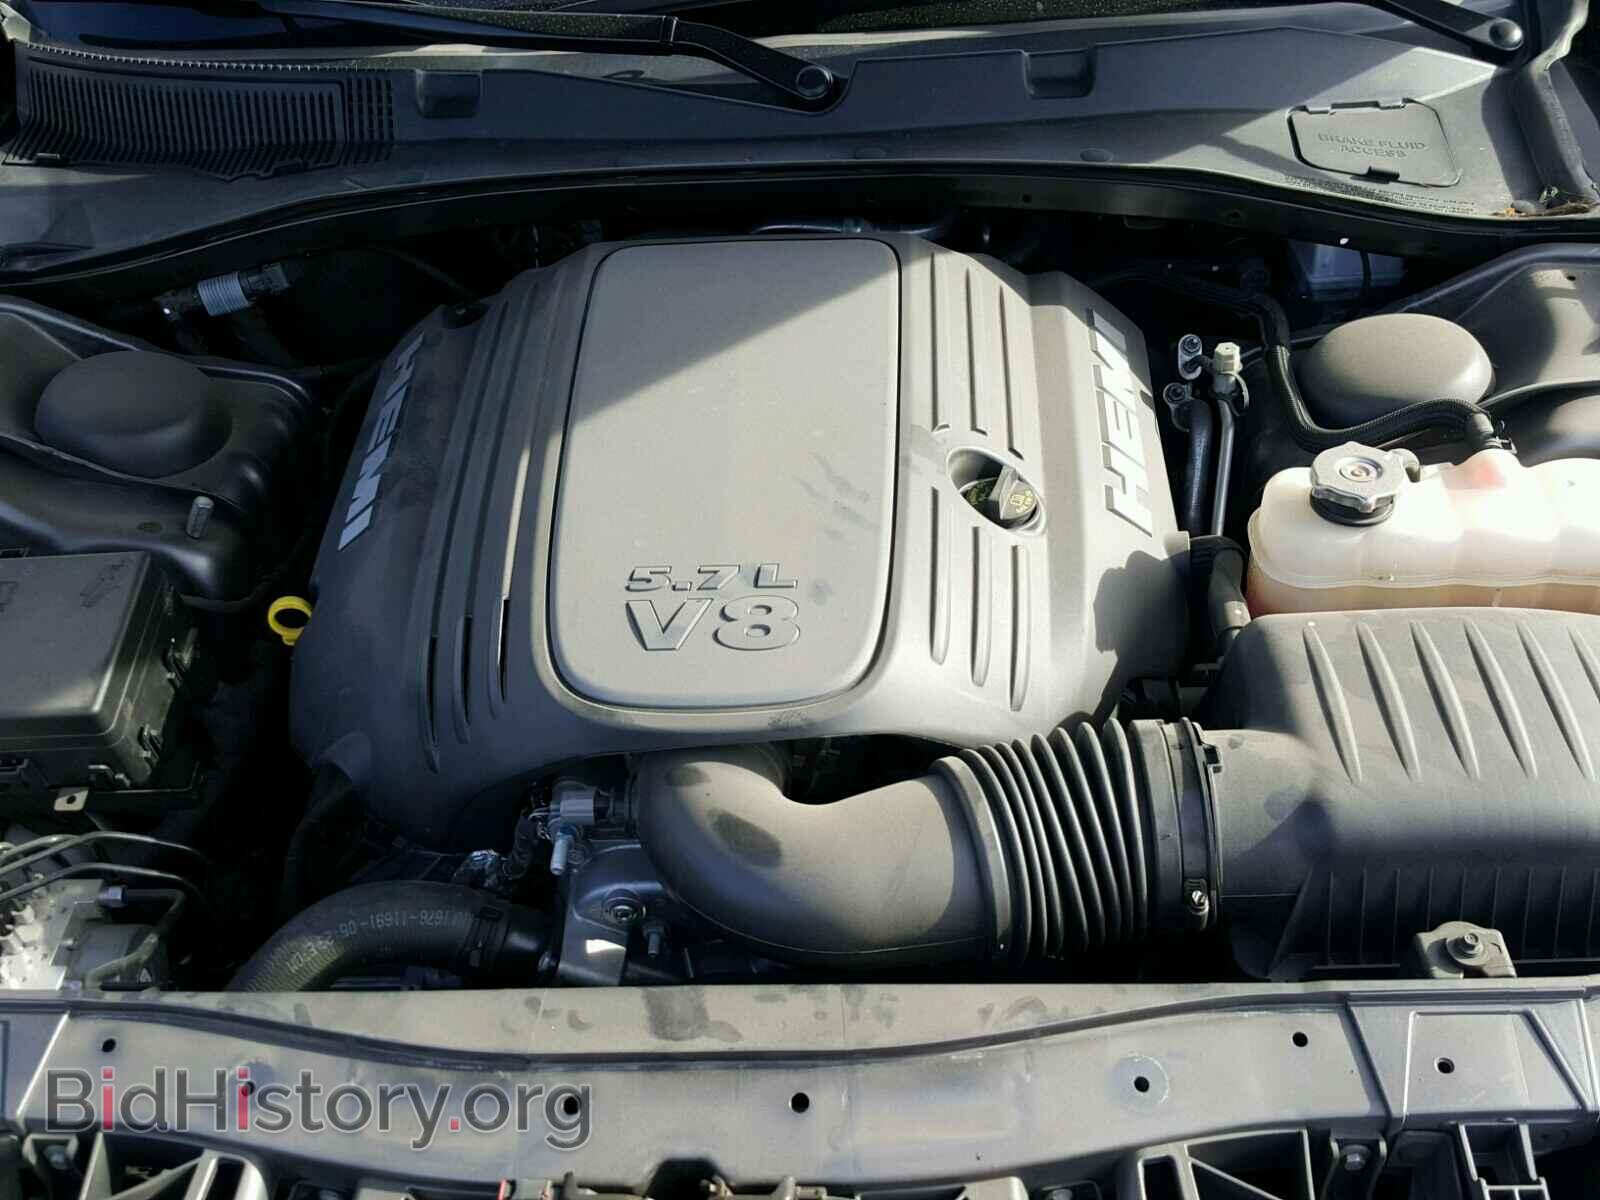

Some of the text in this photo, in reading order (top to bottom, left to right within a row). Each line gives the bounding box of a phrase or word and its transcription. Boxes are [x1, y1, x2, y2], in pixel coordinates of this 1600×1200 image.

[1318, 133, 1426, 151] BRAKE FLUID
[1340, 144, 1408, 159] ACCESS
[1087, 307, 1154, 538] HEMI
[625, 595, 800, 651] V8
